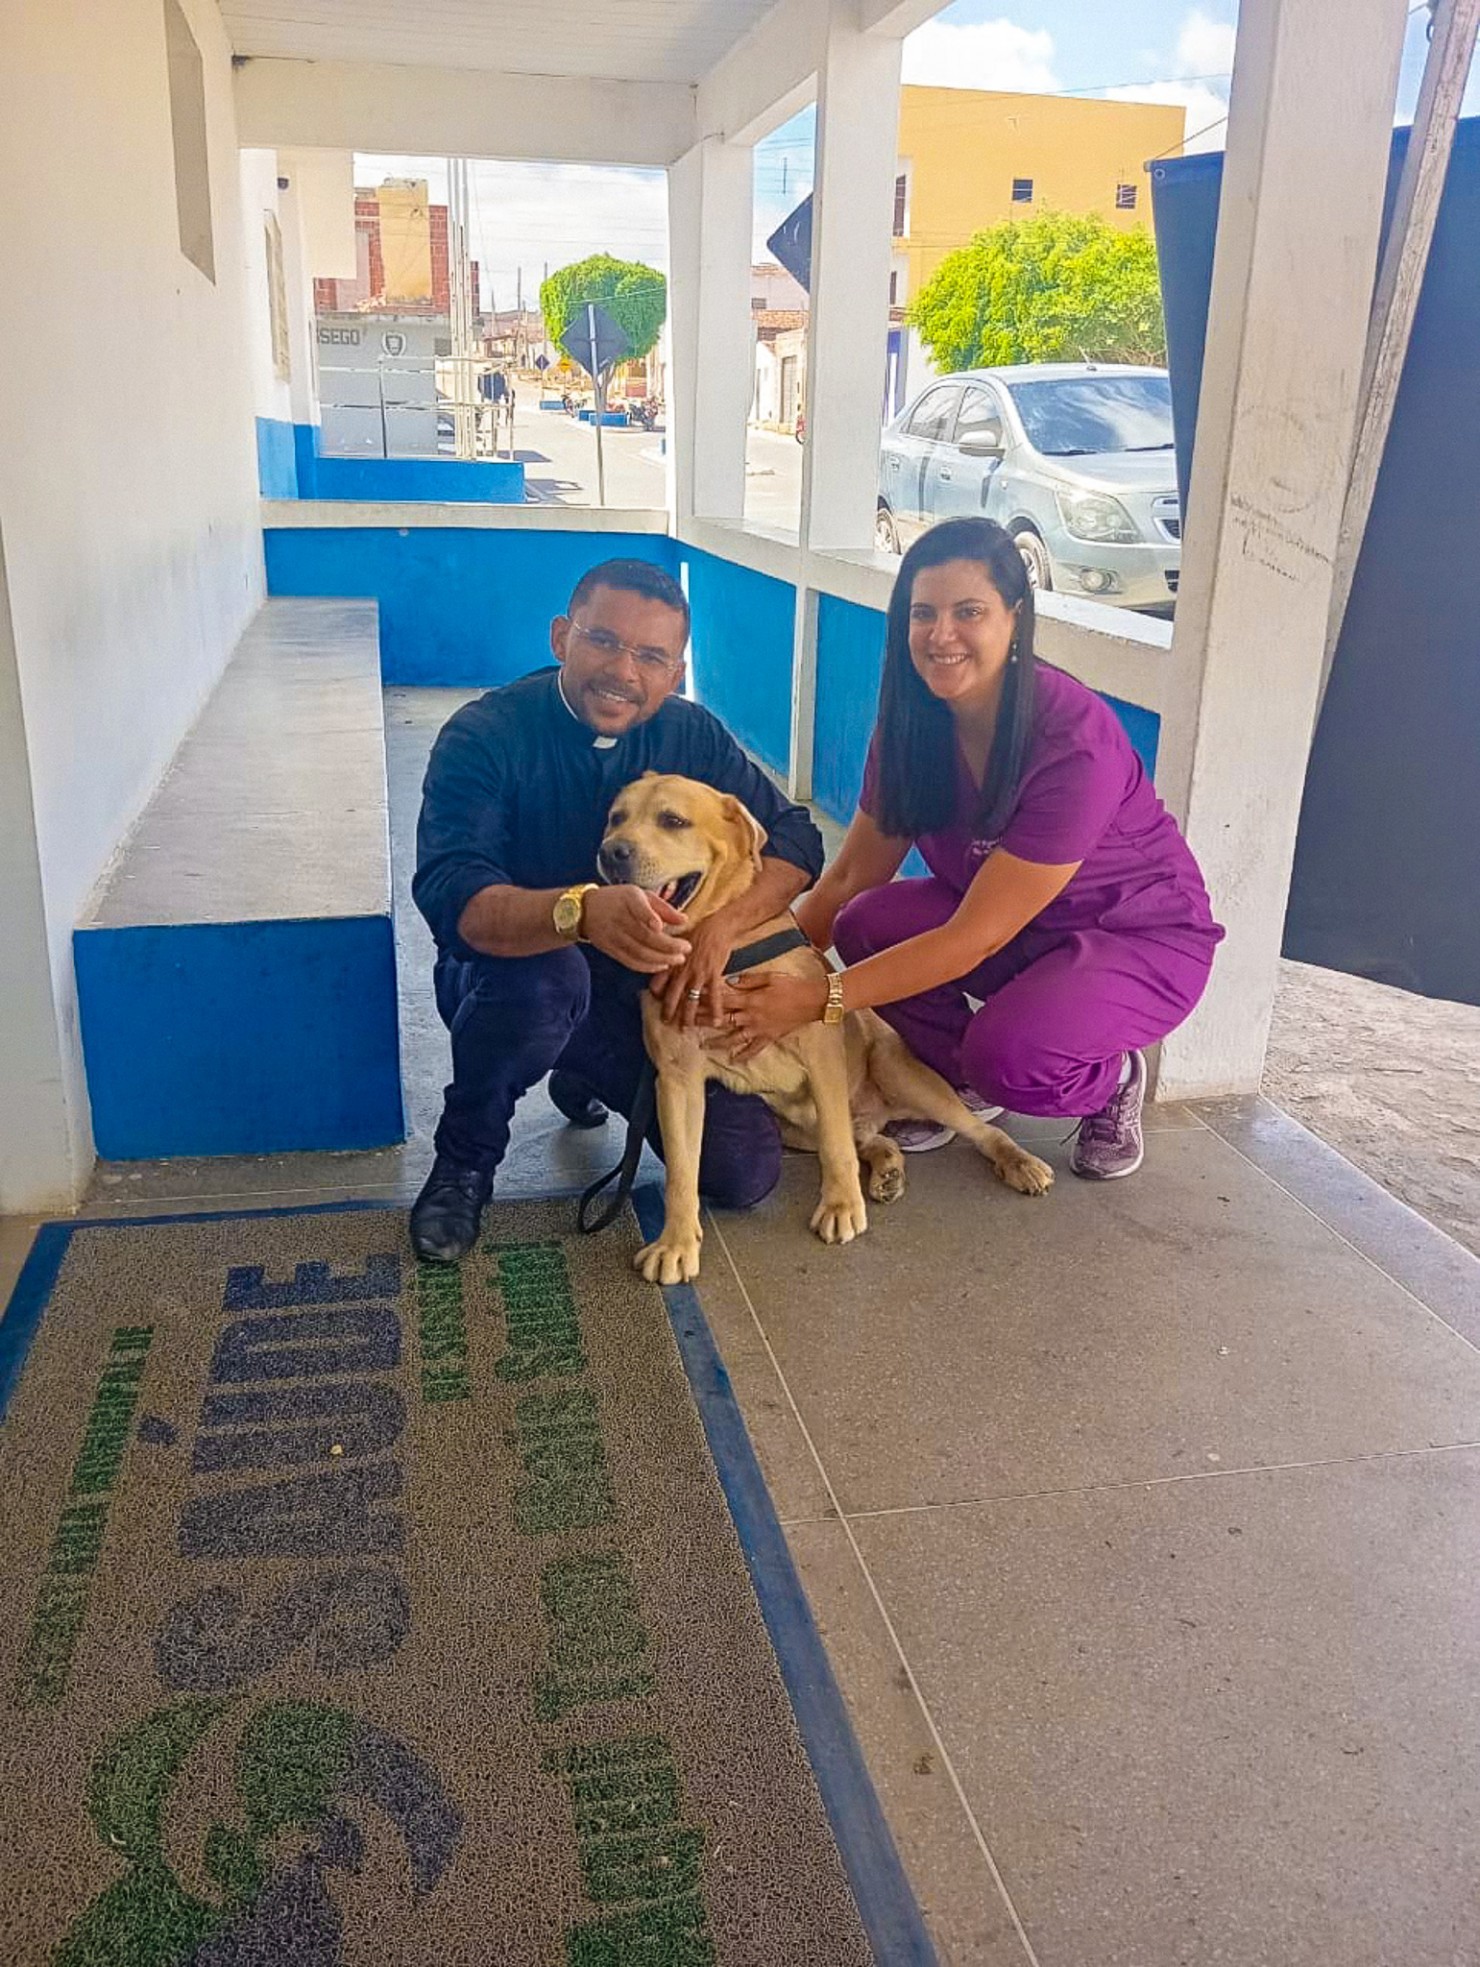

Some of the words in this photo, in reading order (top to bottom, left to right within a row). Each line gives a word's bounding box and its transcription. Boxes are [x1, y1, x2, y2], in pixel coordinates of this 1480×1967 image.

[316, 327, 360, 345] SEGO
[408, 1259, 468, 1361] SOSSÊG
[73, 1353, 145, 1494] MUNICIPAL
[114, 1326, 154, 1350] DE
[420, 1369, 471, 1401] DE
[137, 1254, 409, 1692] SAÚDE
[503, 1387, 615, 1536] Mais
[533, 1553, 652, 1723] Tem
